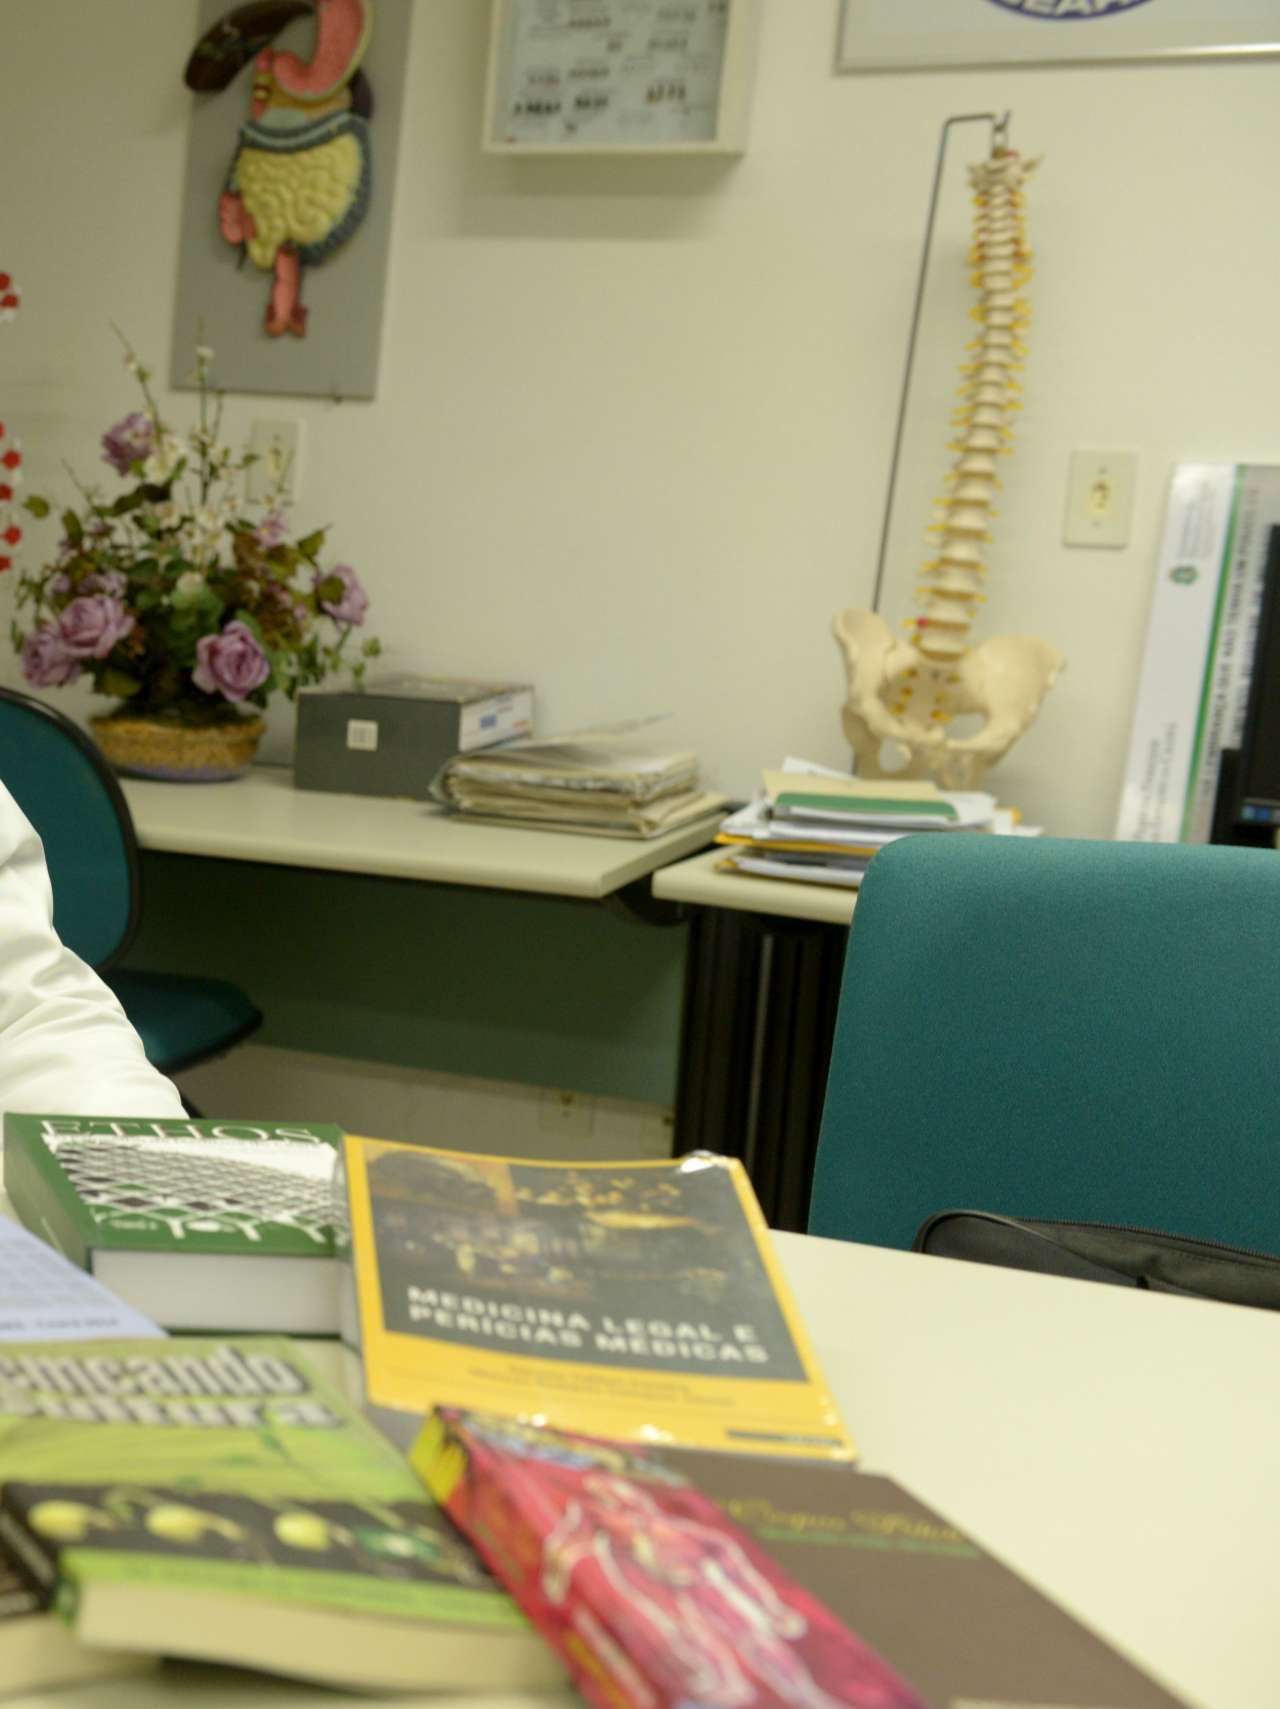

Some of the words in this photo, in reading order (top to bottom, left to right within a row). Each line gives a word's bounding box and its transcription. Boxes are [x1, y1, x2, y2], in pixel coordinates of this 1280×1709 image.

[41, 1120, 322, 1143] ETHOS
[407, 1285, 591, 1332] MEDICINA
[601, 1315, 723, 1343] LEGAL
[732, 1323, 757, 1343] E
